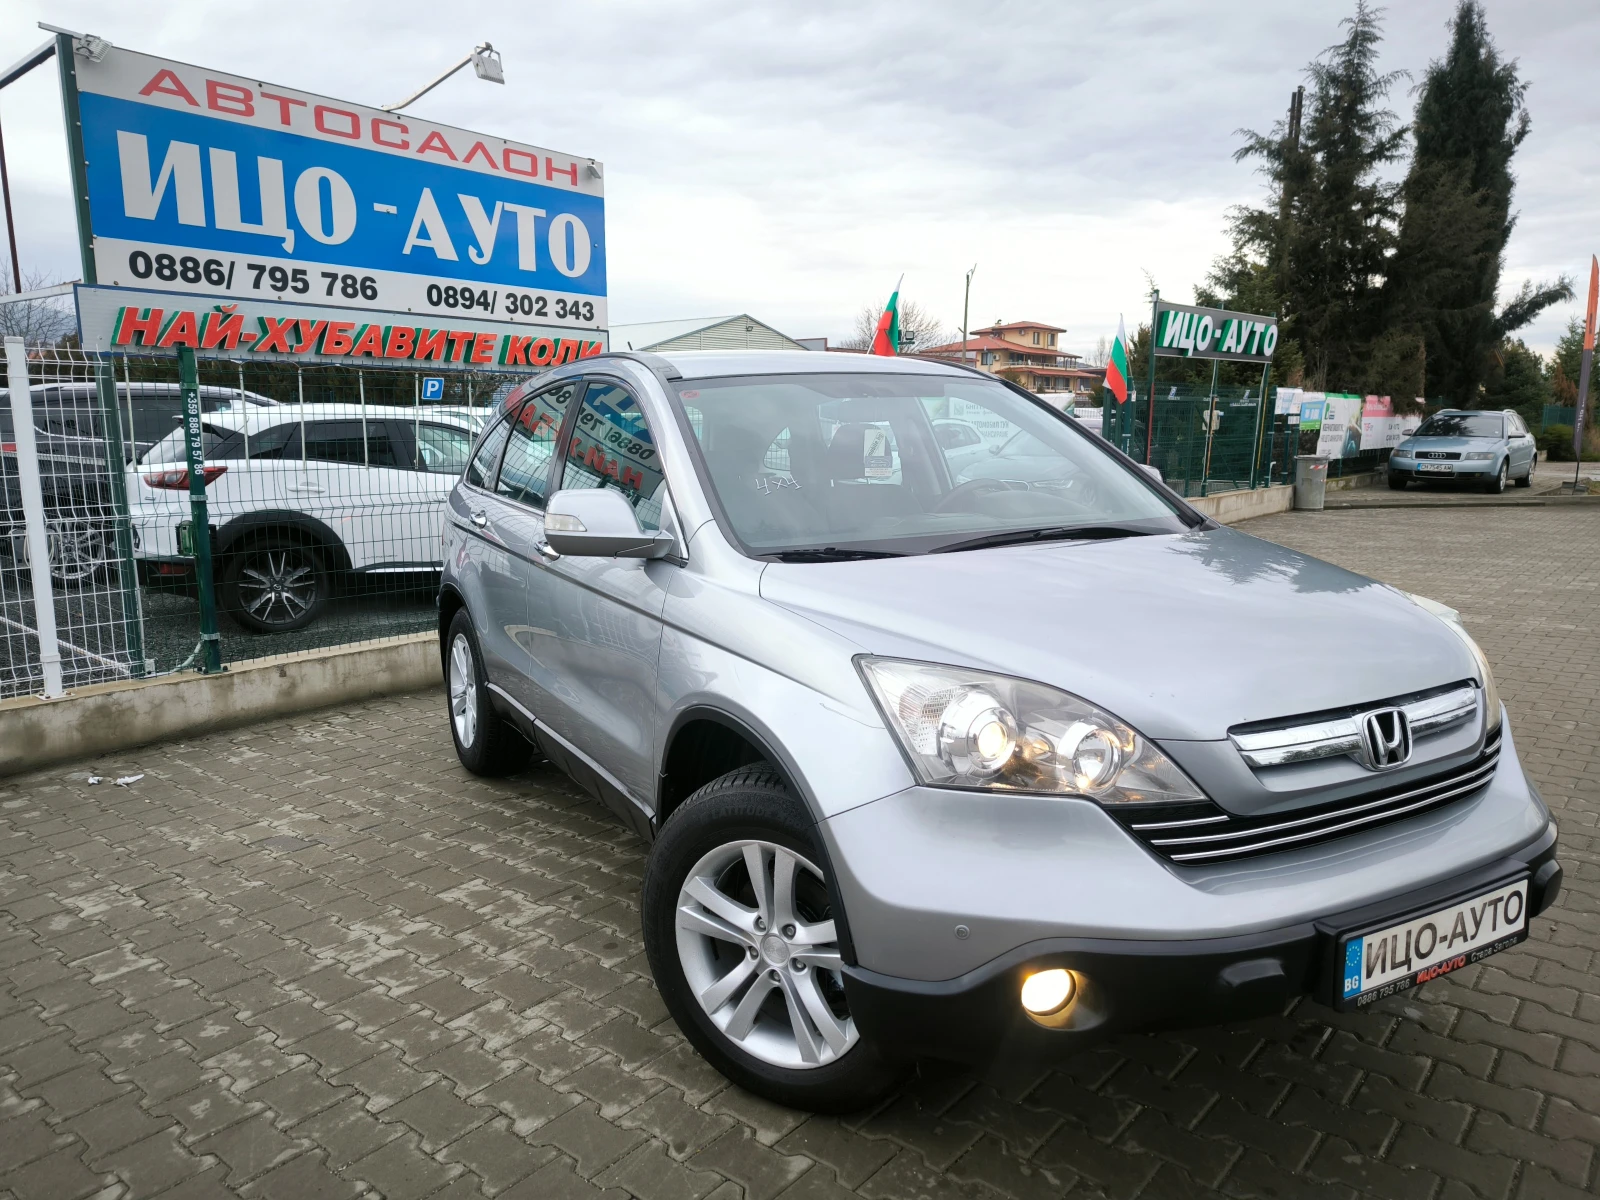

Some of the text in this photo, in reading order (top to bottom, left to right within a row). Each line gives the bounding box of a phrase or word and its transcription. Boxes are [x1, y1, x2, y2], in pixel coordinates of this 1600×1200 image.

[138, 68, 578, 187] АВТОСАЛОН
[128, 250, 378, 301] 0886/ 795 786
[426, 283, 594, 322] 0894/ 302 343
[113, 303, 603, 366] НАЙ-ХУБАВИТЕ КОЛИ
[1160, 310, 1278, 357] ИЦО-АУТО
[187, 391, 204, 475] +359 886 79 57 86
[1365, 889, 1524, 980] ИЦО-АУТО
[1344, 975, 1359, 993] BG
[1416, 955, 1467, 984] ИЦО-АУТО
[1471, 947, 1493, 962] Стара
